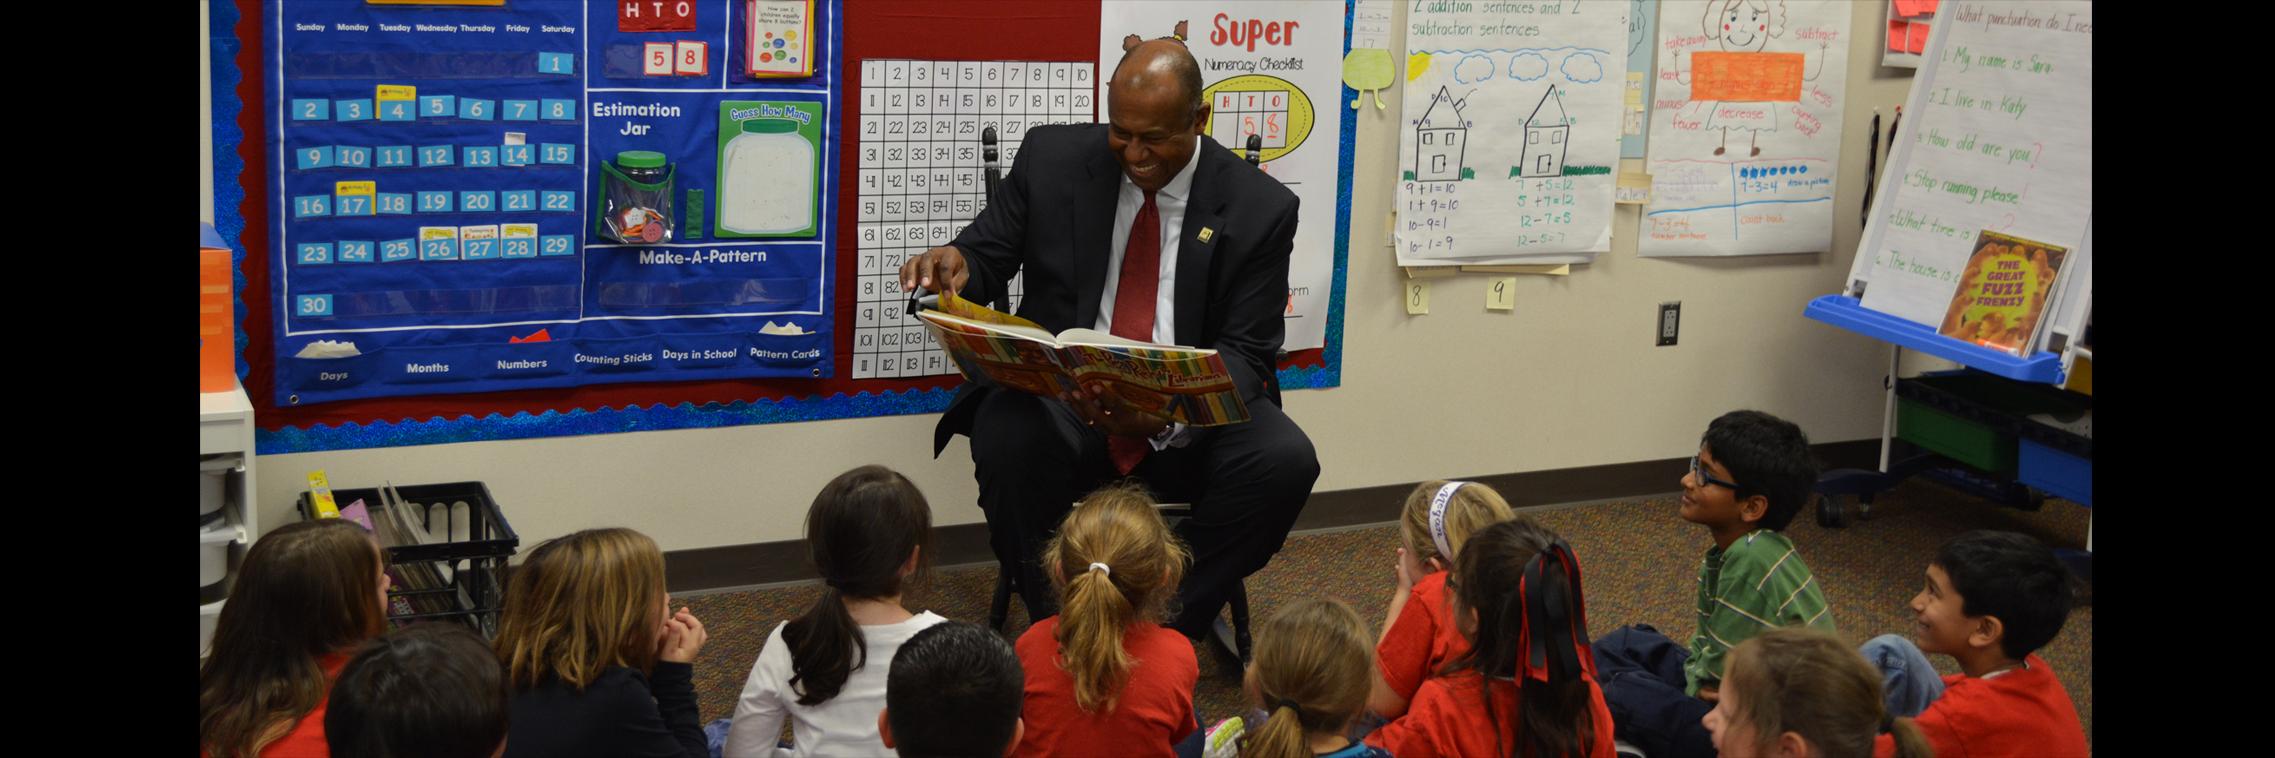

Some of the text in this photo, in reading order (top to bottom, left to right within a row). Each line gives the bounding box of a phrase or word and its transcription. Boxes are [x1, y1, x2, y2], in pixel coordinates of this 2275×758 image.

[626, 1, 690, 18] H T O
[1427, 0, 1473, 14] addition
[1482, 1, 1535, 15] sentences
[1540, 0, 1561, 15] and
[1571, 0, 1581, 14] 2
[1955, 5, 1983, 23] What
[1985, 10, 2041, 32] punctuation
[2046, 14, 2060, 30] do
[296, 23, 575, 34] Sunday Monday Tuesday Wednesday Thursday Friday Saturday
[1210, 12, 1300, 52] Super
[1412, 21, 1540, 37] subtraction sentences
[1795, 28, 1839, 42] subtract
[552, 57, 560, 71] 1
[653, 49, 696, 67] 5 8
[1204, 57, 1304, 73] Numeracy Checklist
[1953, 46, 1971, 73] My
[1978, 55, 2006, 68] name
[2012, 59, 2022, 70] is
[871, 67, 1088, 81] 1 2 3 4 5 6 7 8 9 10
[870, 94, 1090, 108] 11 12 13 14 15 16 17 18 19 20
[1222, 96, 1280, 108] H T O
[1955, 90, 1974, 108] live
[1981, 99, 1992, 110] in
[2000, 95, 2027, 120] Katy
[305, 99, 564, 119] 2 3 4 5 6 7 8
[593, 102, 681, 118] Estimation
[731, 105, 811, 123] Guess How Many
[1718, 109, 1764, 119] decrease
[620, 121, 651, 136] Jar
[867, 121, 975, 134] 21 22 23 24 25
[1243, 113, 1279, 136] 5 8
[1928, 128, 1949, 148] How
[1956, 133, 1978, 151] old
[1982, 143, 2002, 157] are
[309, 147, 568, 165] 9 10 11 12 13 14 15
[1912, 169, 1937, 192] Stop
[302, 194, 569, 214] 16 17 18 19 20 21 22
[304, 238, 567, 262] 23 24 25 26 27 28 29
[639, 249, 767, 265] Make-A-Pattern
[1997, 261, 2021, 270] THE
[1987, 271, 2026, 281] GREAT
[1412, 285, 1422, 306] 8
[1494, 281, 1504, 303] 9
[1982, 282, 2025, 295] FUZZ
[303, 298, 326, 313] 30
[1976, 296, 2025, 307] FRENZY
[574, 352, 653, 366] Counting Sticks
[663, 348, 737, 361] Days in School
[750, 347, 820, 359] Pattern Cards
[407, 363, 449, 374] Months
[497, 358, 548, 370] Numbers
[320, 370, 349, 382] Days
[1431, 486, 1450, 538] Megan
